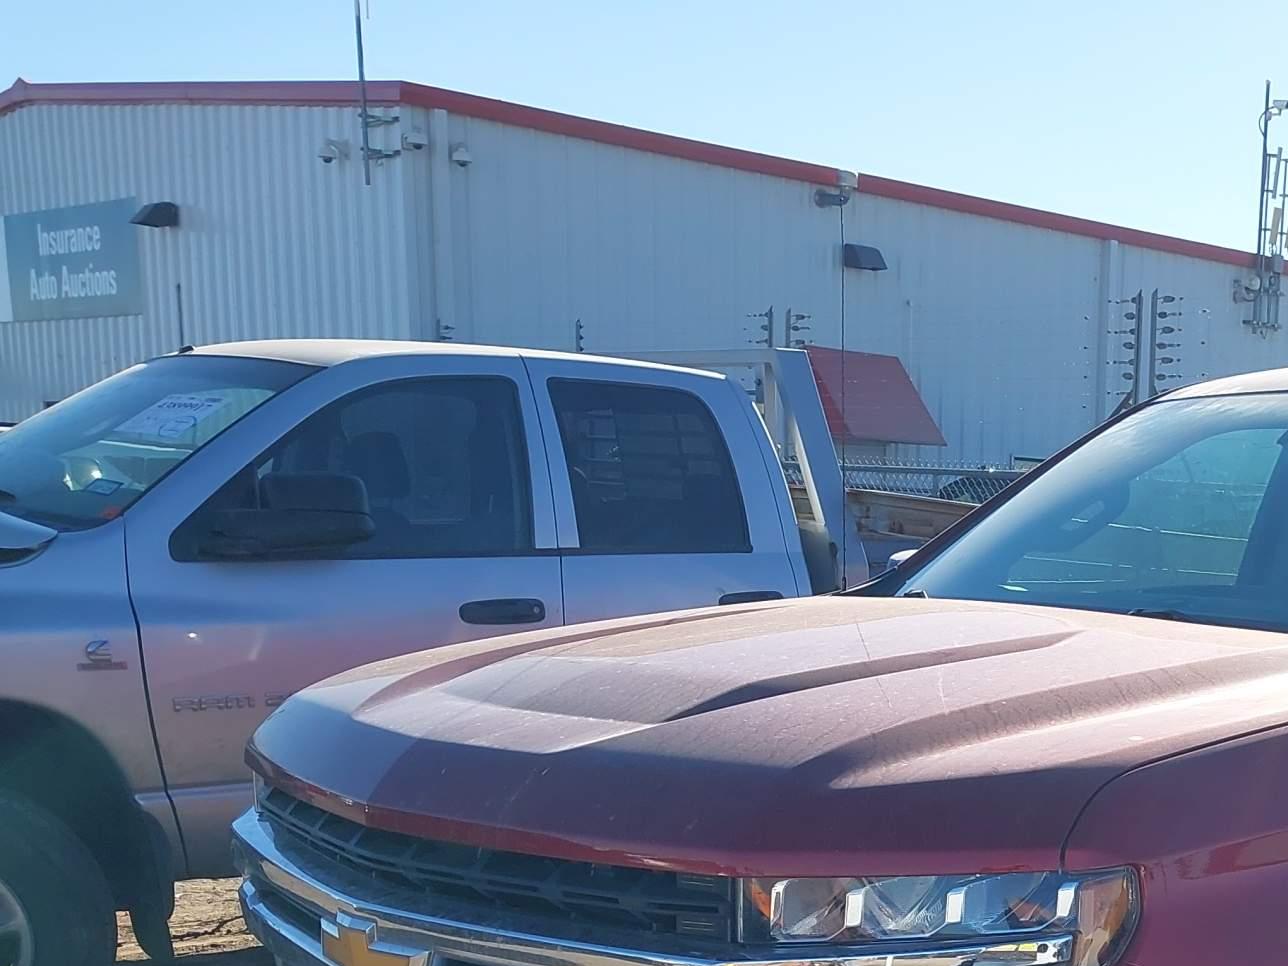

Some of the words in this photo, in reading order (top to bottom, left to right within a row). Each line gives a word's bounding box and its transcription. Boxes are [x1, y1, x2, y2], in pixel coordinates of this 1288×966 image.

[37, 223, 101, 256] Insurance
[30, 267, 58, 301] Auto
[61, 262, 118, 298] Auctions
[171, 695, 256, 713] RAM
